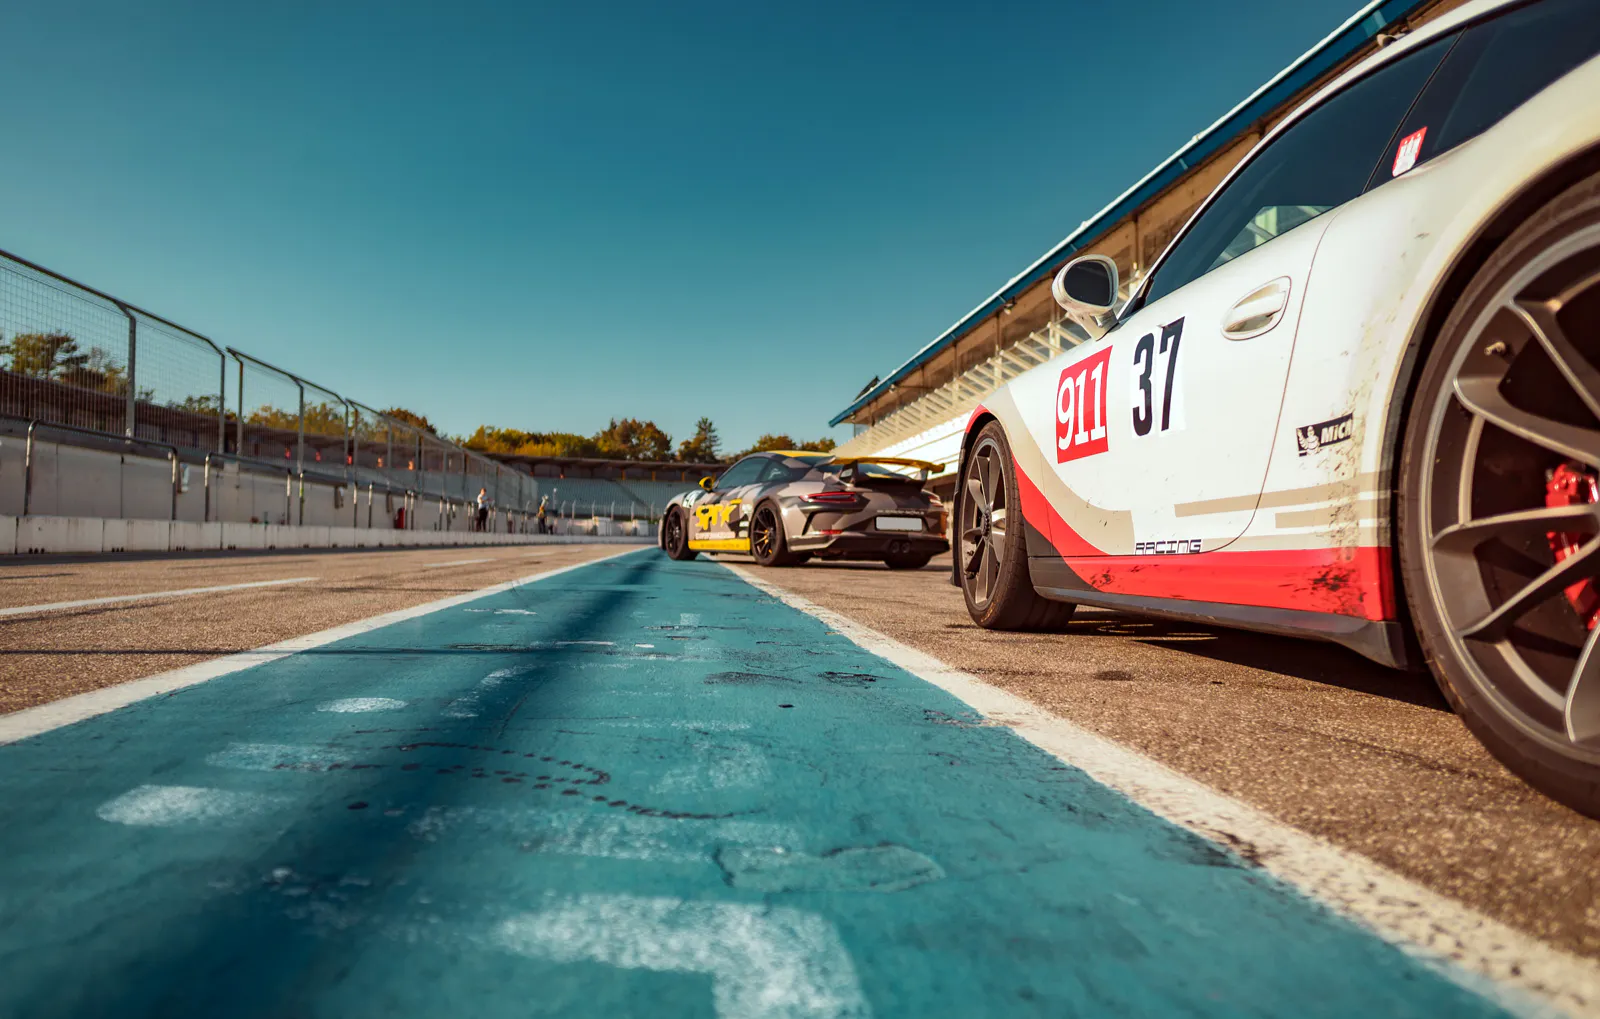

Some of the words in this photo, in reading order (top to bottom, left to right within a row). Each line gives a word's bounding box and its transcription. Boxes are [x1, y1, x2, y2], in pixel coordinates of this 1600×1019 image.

[1057, 361, 1106, 450] 911
[1132, 316, 1185, 436] 37
[1135, 539, 1202, 555] RACING
